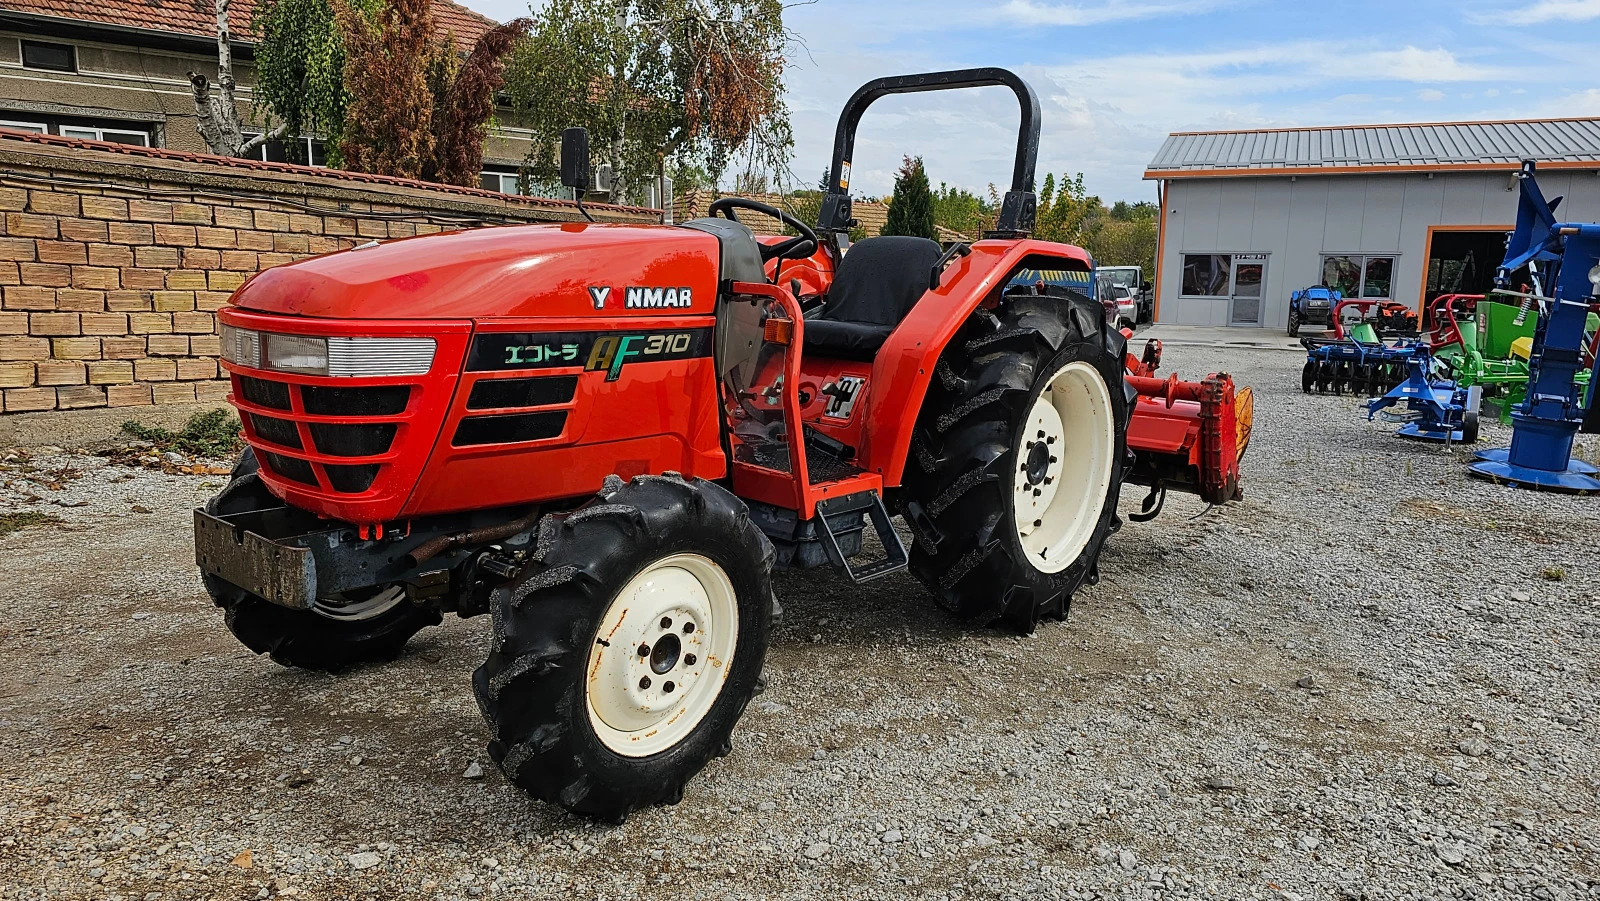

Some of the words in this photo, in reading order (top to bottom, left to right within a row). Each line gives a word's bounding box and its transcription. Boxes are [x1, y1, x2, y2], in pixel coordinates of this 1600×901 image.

[588, 286, 692, 309] YNMAR
[504, 343, 579, 364] エコトラ
[584, 335, 645, 381] AF
[643, 333, 691, 355] 310
